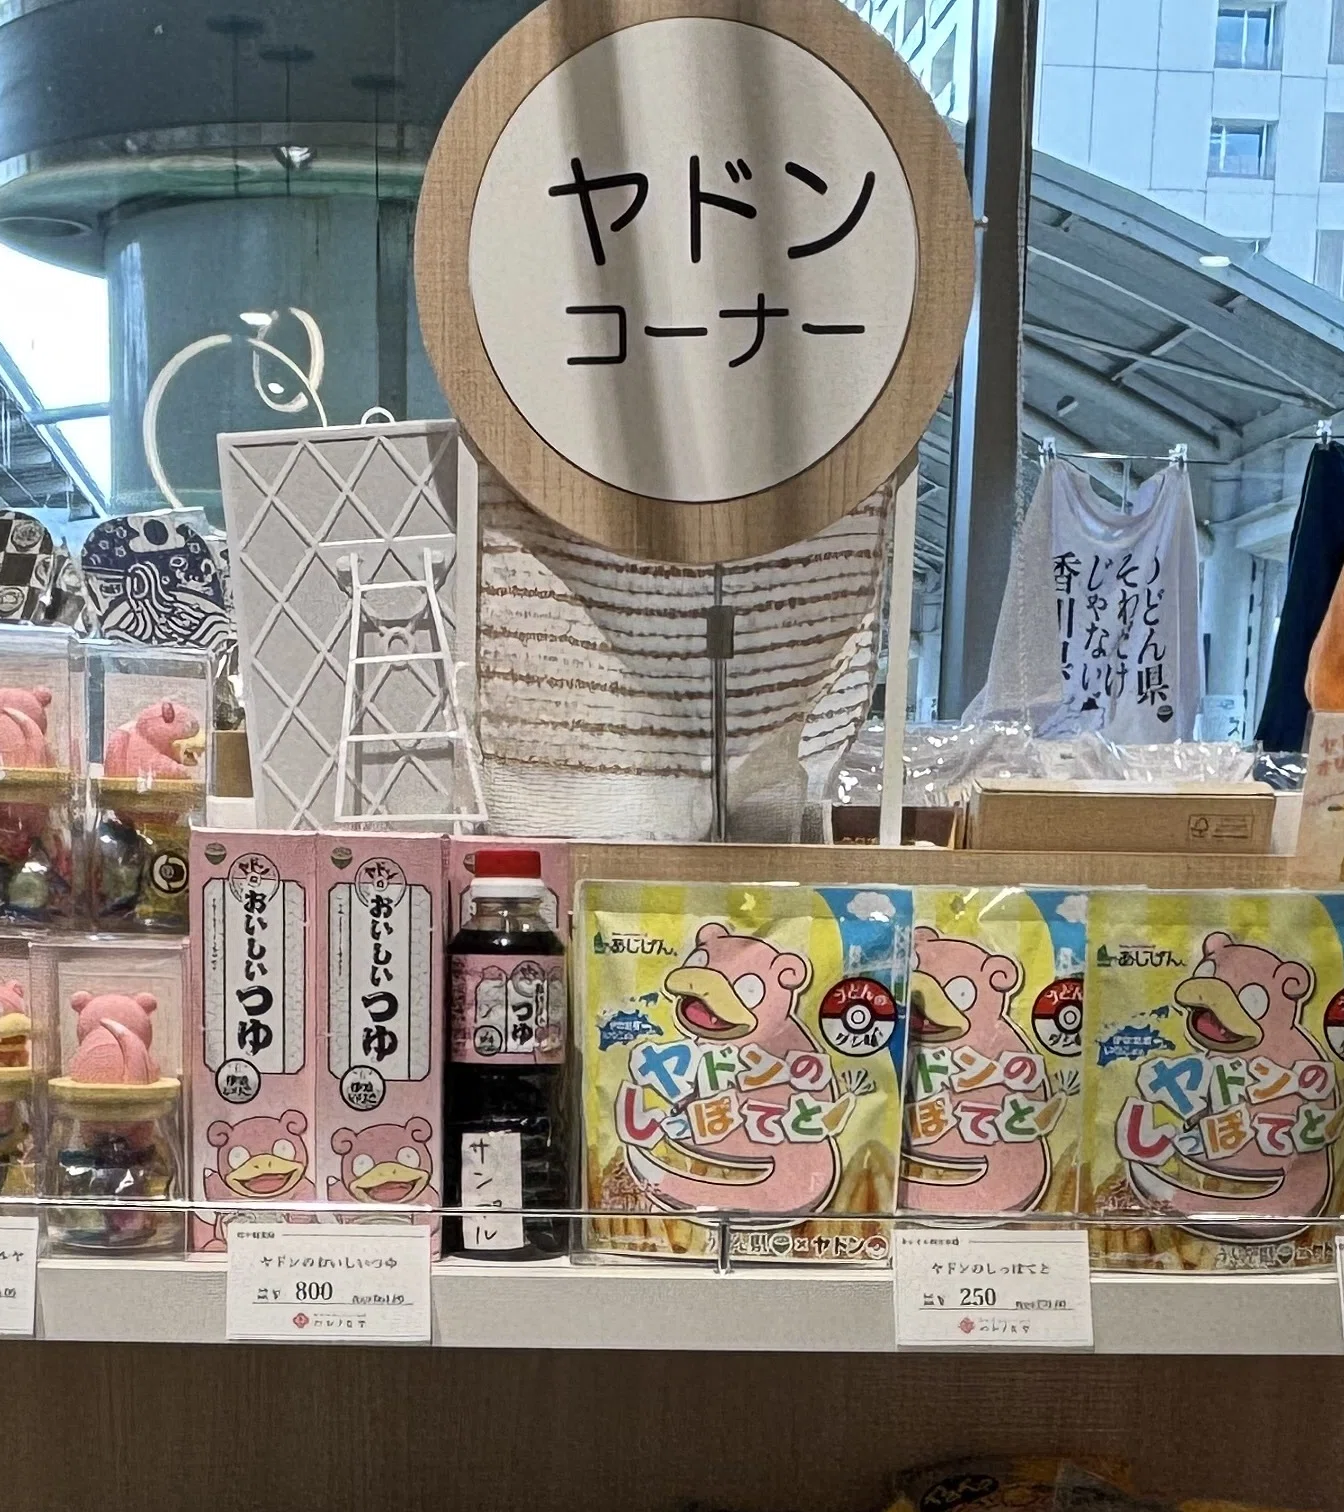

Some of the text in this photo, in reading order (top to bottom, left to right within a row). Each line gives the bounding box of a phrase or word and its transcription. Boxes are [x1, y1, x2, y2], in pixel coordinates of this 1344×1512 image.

[547, 155, 877, 267] ヤドン
[564, 292, 867, 370] コーナー
[235, 889, 274, 1057] おいしいつゆ
[361, 894, 399, 1063] おいしいつゆ
[1046, 980, 1083, 1001] うどん
[637, 1044, 824, 1101] ヤドンの
[918, 1049, 1036, 1093] ドンの
[1149, 1057, 1327, 1118] ヤドンの
[624, 1087, 824, 1142] しっぽてと
[909, 1098, 1034, 1140] ぽてと
[1126, 1104, 1326, 1158] しっぽてと
[294, 1280, 334, 1301] 800
[958, 1285, 998, 1308] 250
